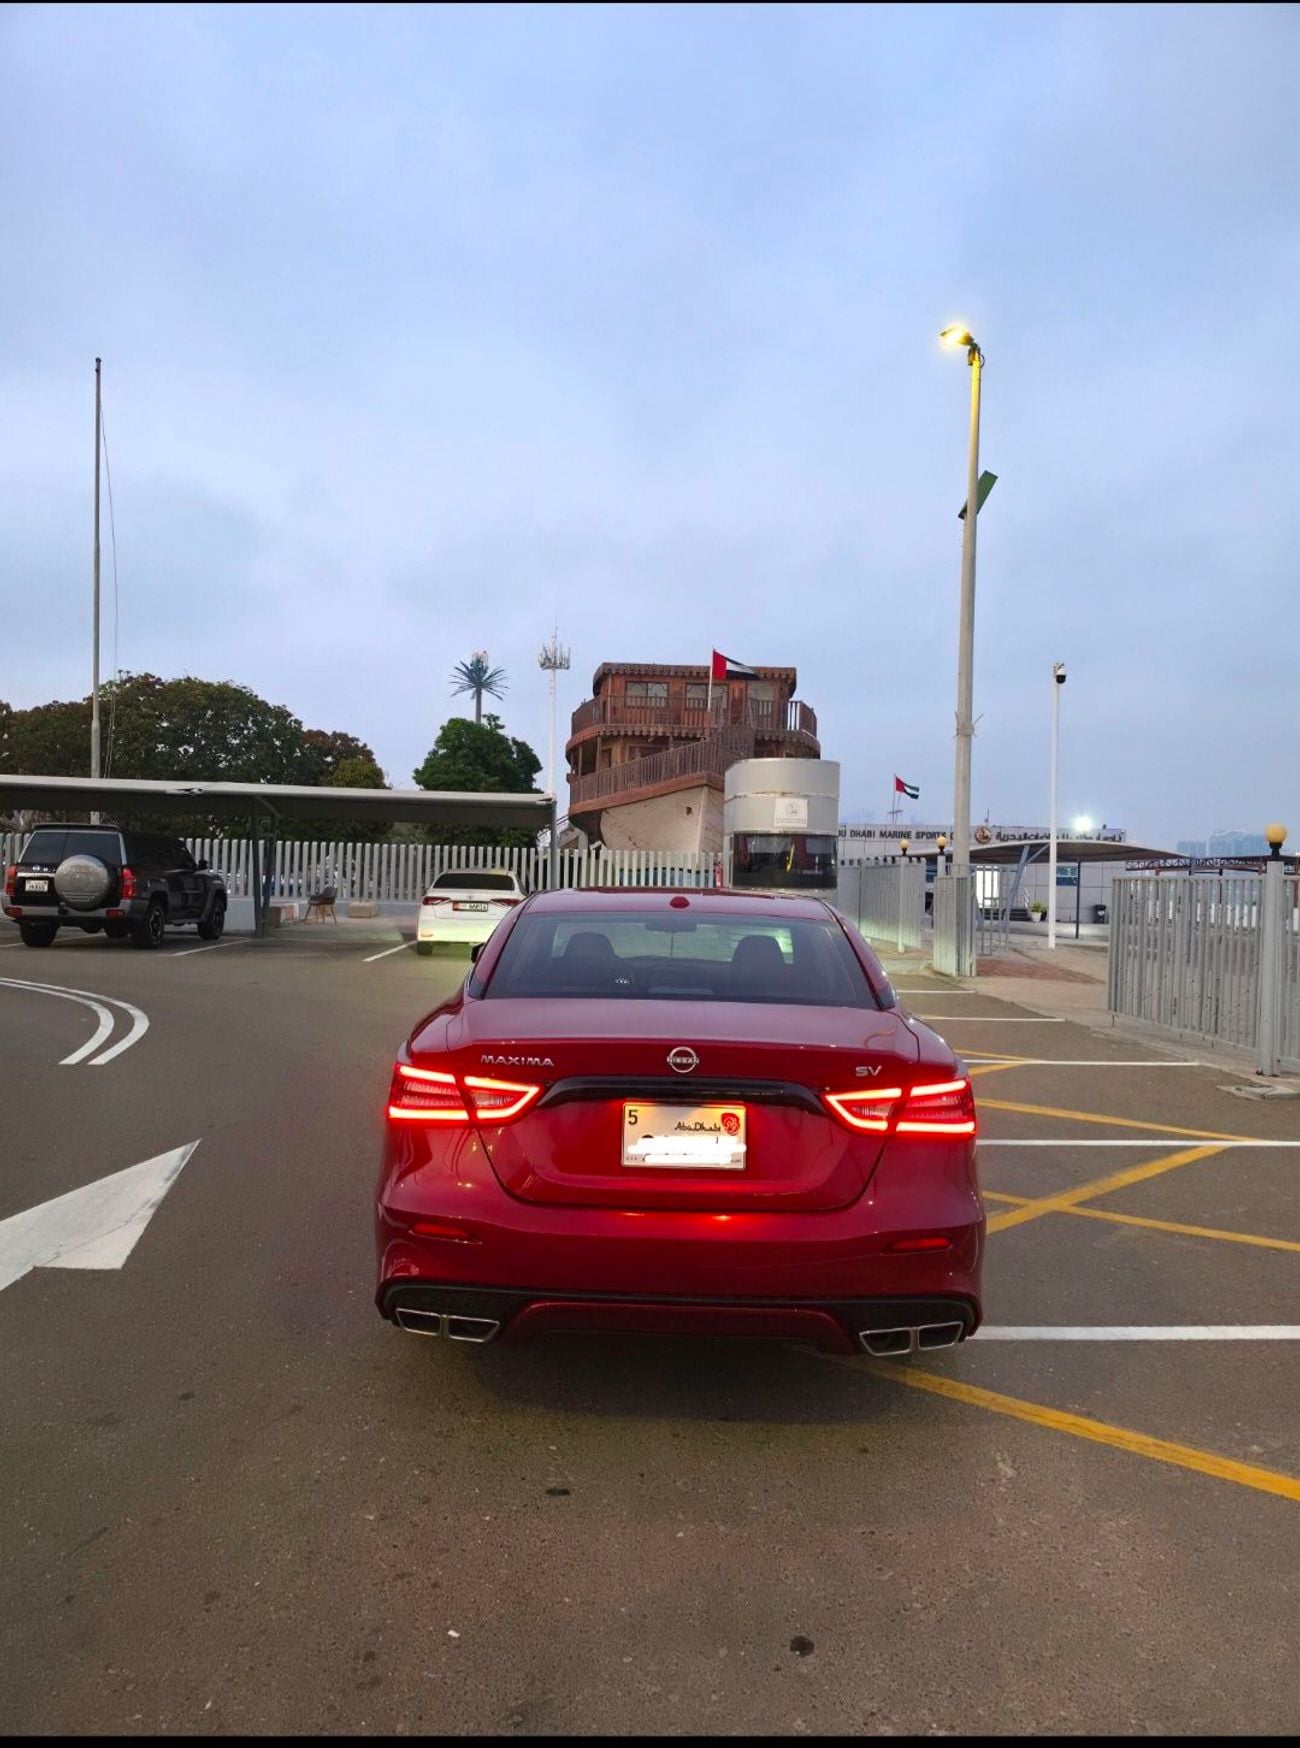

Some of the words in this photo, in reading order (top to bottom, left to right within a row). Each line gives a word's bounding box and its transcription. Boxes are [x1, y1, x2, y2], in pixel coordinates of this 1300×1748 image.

[850, 829, 876, 838] DHABI
[879, 829, 912, 839] MARINE
[480, 1054, 554, 1067] MAXIMA
[855, 1065, 882, 1077] SV
[628, 1109, 638, 1125] 5
